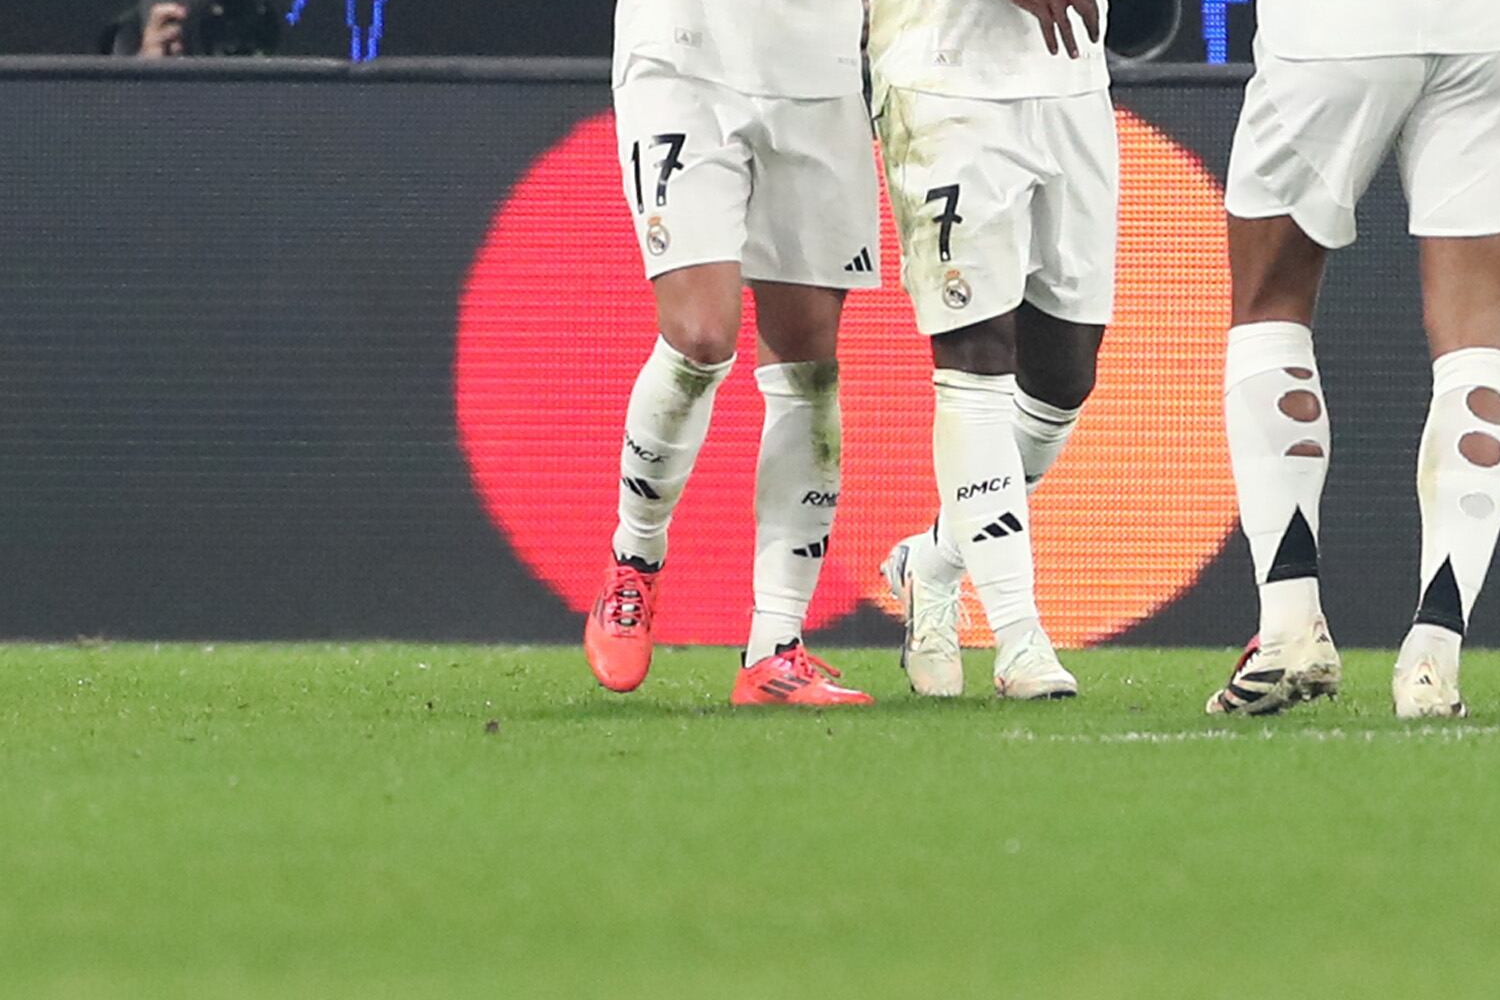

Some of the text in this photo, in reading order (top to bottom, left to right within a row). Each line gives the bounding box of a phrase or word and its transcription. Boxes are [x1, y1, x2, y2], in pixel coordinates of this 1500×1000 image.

[632, 133, 687, 214] 17
[925, 184, 963, 262] 7
[626, 431, 670, 464] MCF
[801, 490, 839, 507] RM
[956, 476, 1011, 501] RMCF
